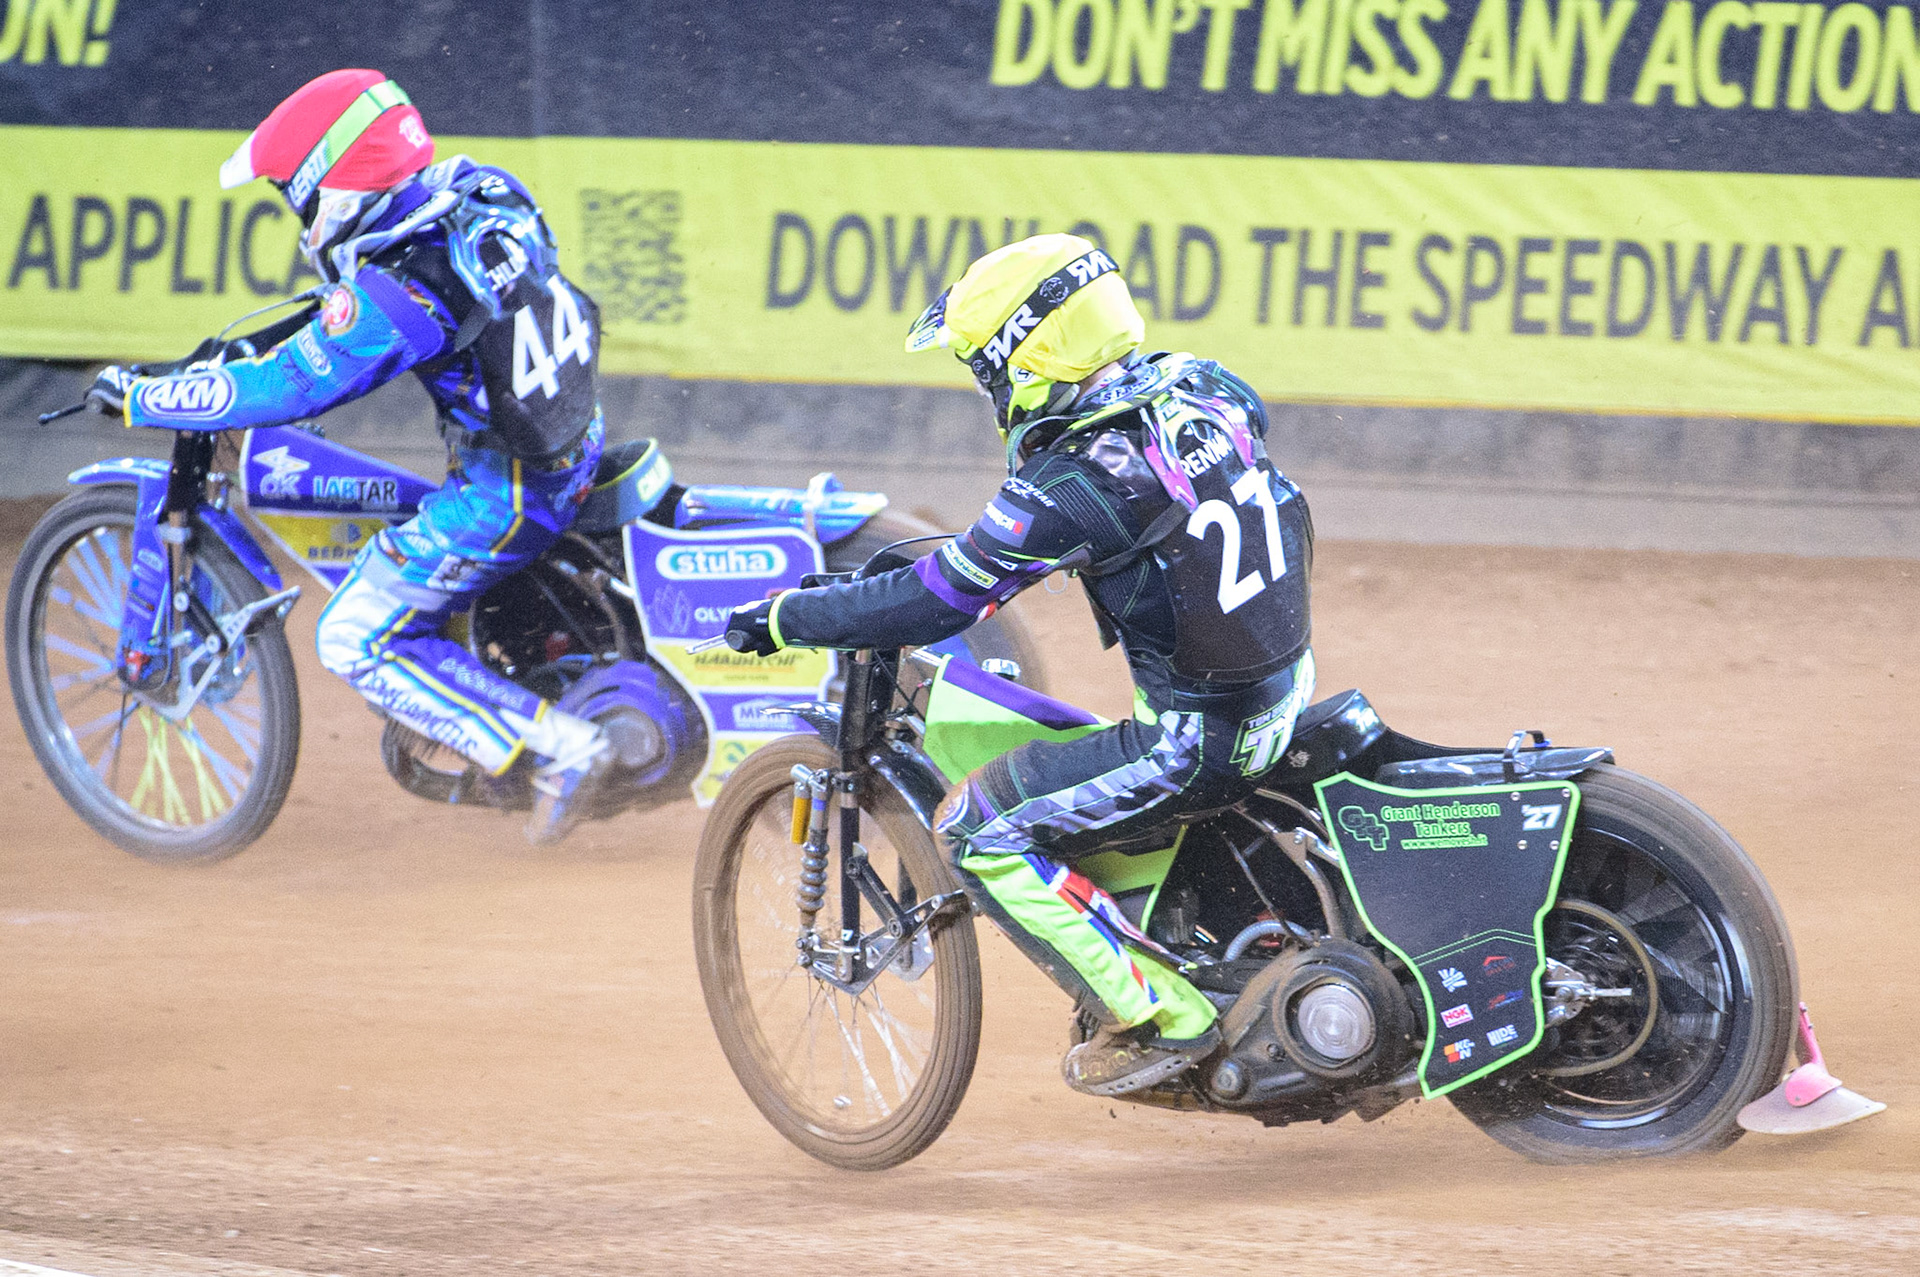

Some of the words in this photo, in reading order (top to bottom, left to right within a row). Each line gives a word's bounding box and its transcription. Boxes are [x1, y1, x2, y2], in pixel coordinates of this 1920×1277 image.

[1254, 0, 1449, 99] MISS
[1449, 0, 1637, 103] ANY
[1249, 227, 1393, 330] THE
[1409, 233, 1844, 348] SPEEDWAY
[1858, 248, 1920, 350] A
[512, 273, 594, 400] 44
[148, 374, 222, 410] AKM
[313, 475, 400, 508] LABTAR
[1185, 466, 1288, 615] 27
[676, 549, 769, 574] stuha
[1380, 805, 1421, 821] Grant
[1421, 801, 1501, 820] Henderson
[1521, 803, 1563, 831] 27
[1413, 819, 1471, 838] Tankers
[1444, 1007, 1469, 1021] NGK
